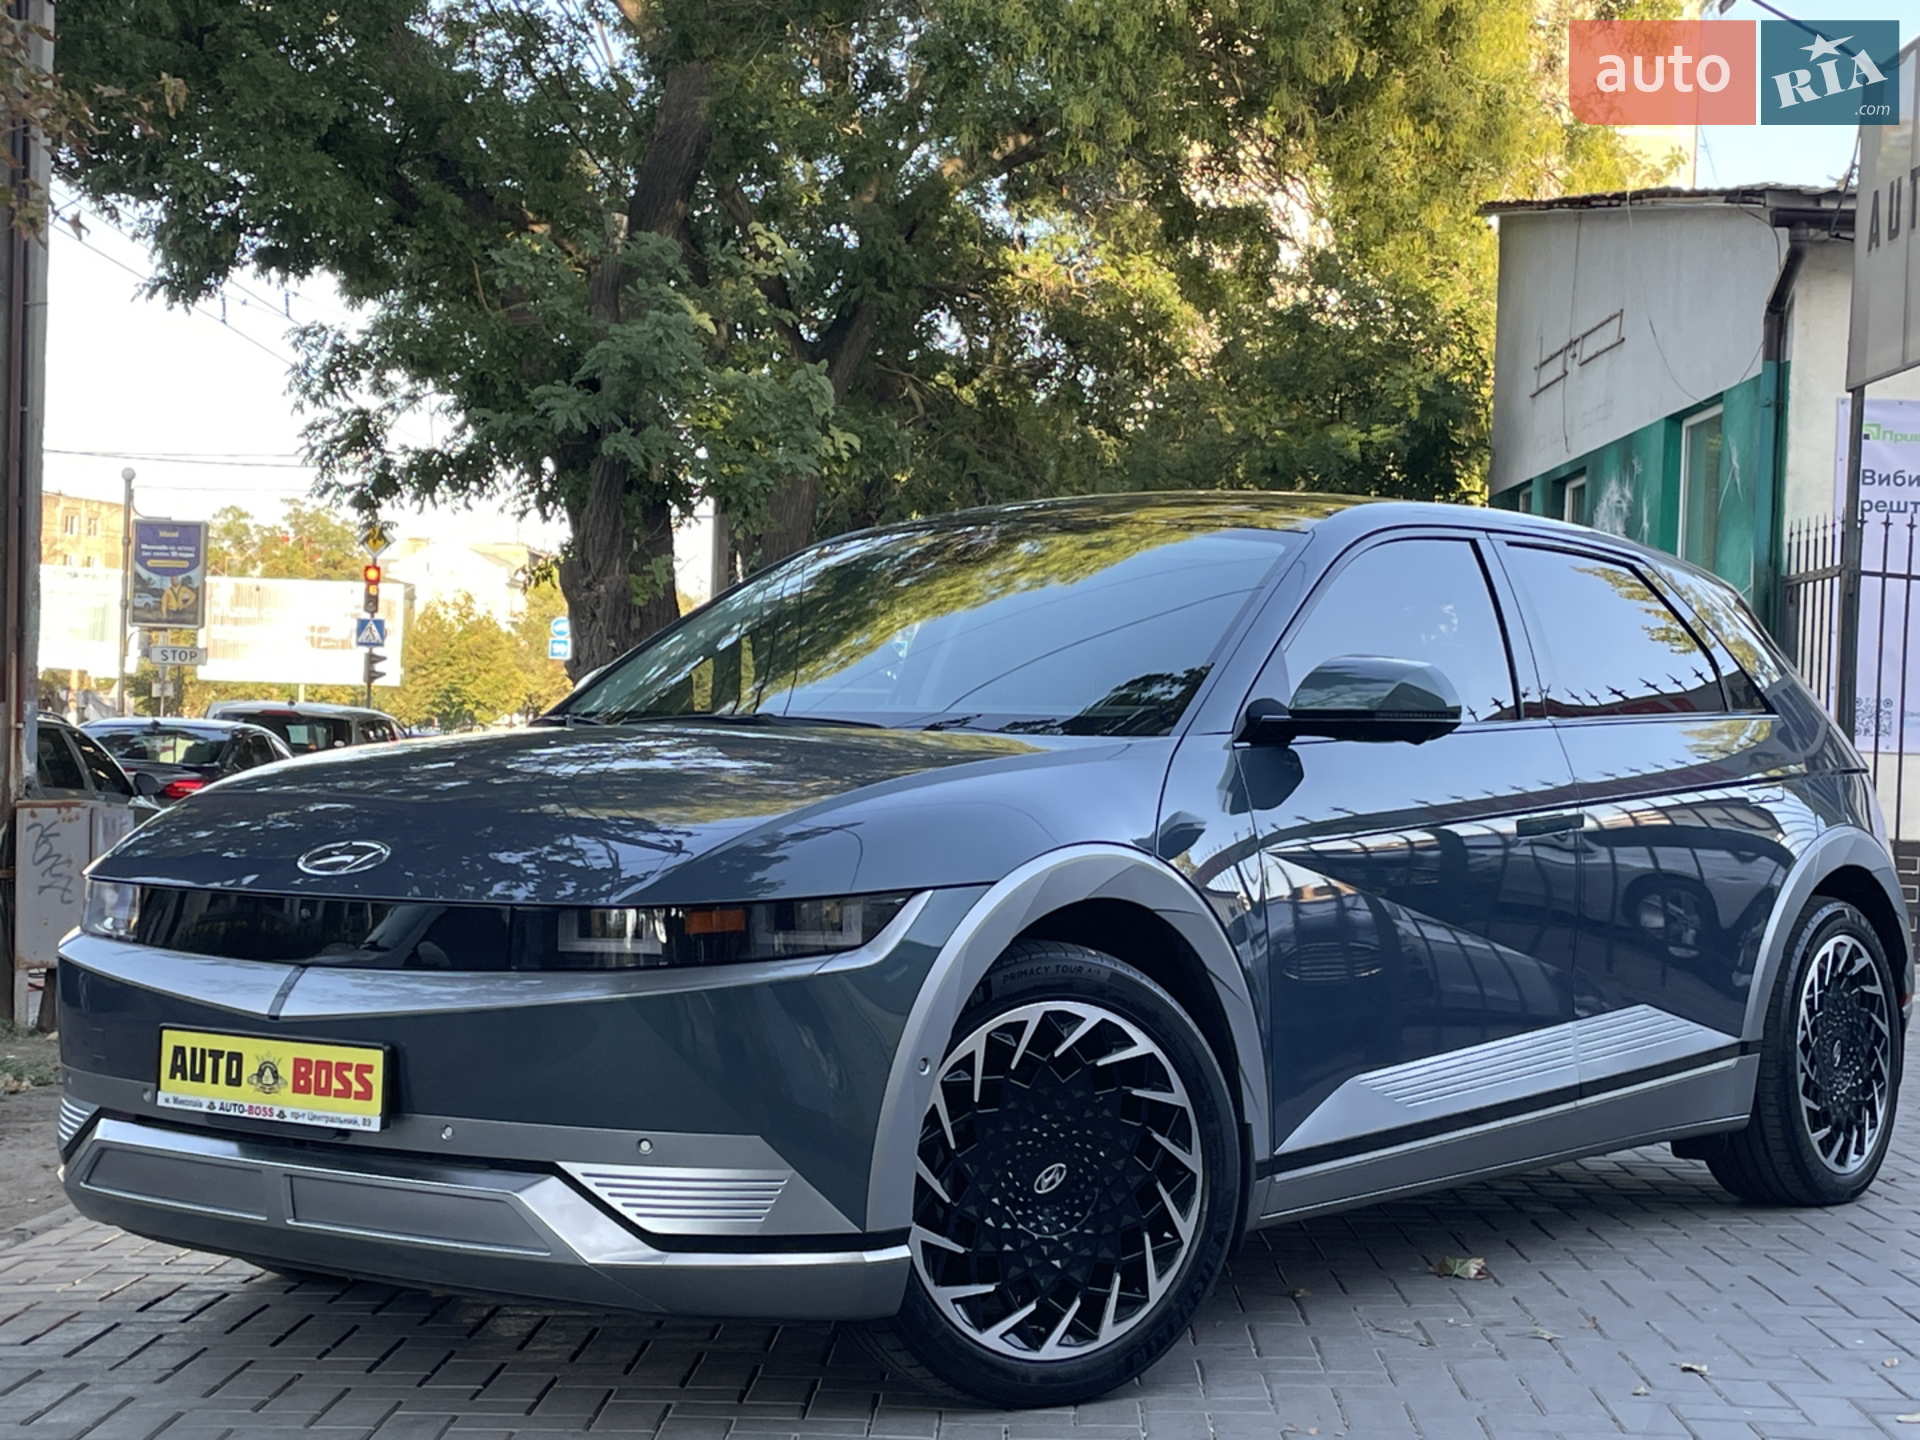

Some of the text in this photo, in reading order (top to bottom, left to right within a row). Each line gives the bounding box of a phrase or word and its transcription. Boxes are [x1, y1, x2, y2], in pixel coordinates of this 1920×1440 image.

[1862, 469, 1920, 487] Виби
[161, 650, 198, 662] STOP
[1002, 965, 1050, 984] PRIMACY
[1055, 965, 1084, 974] TOUR
[169, 1045, 374, 1101] AUTO BOSS
[218, 1102, 274, 1118] AUTO-BOSS
